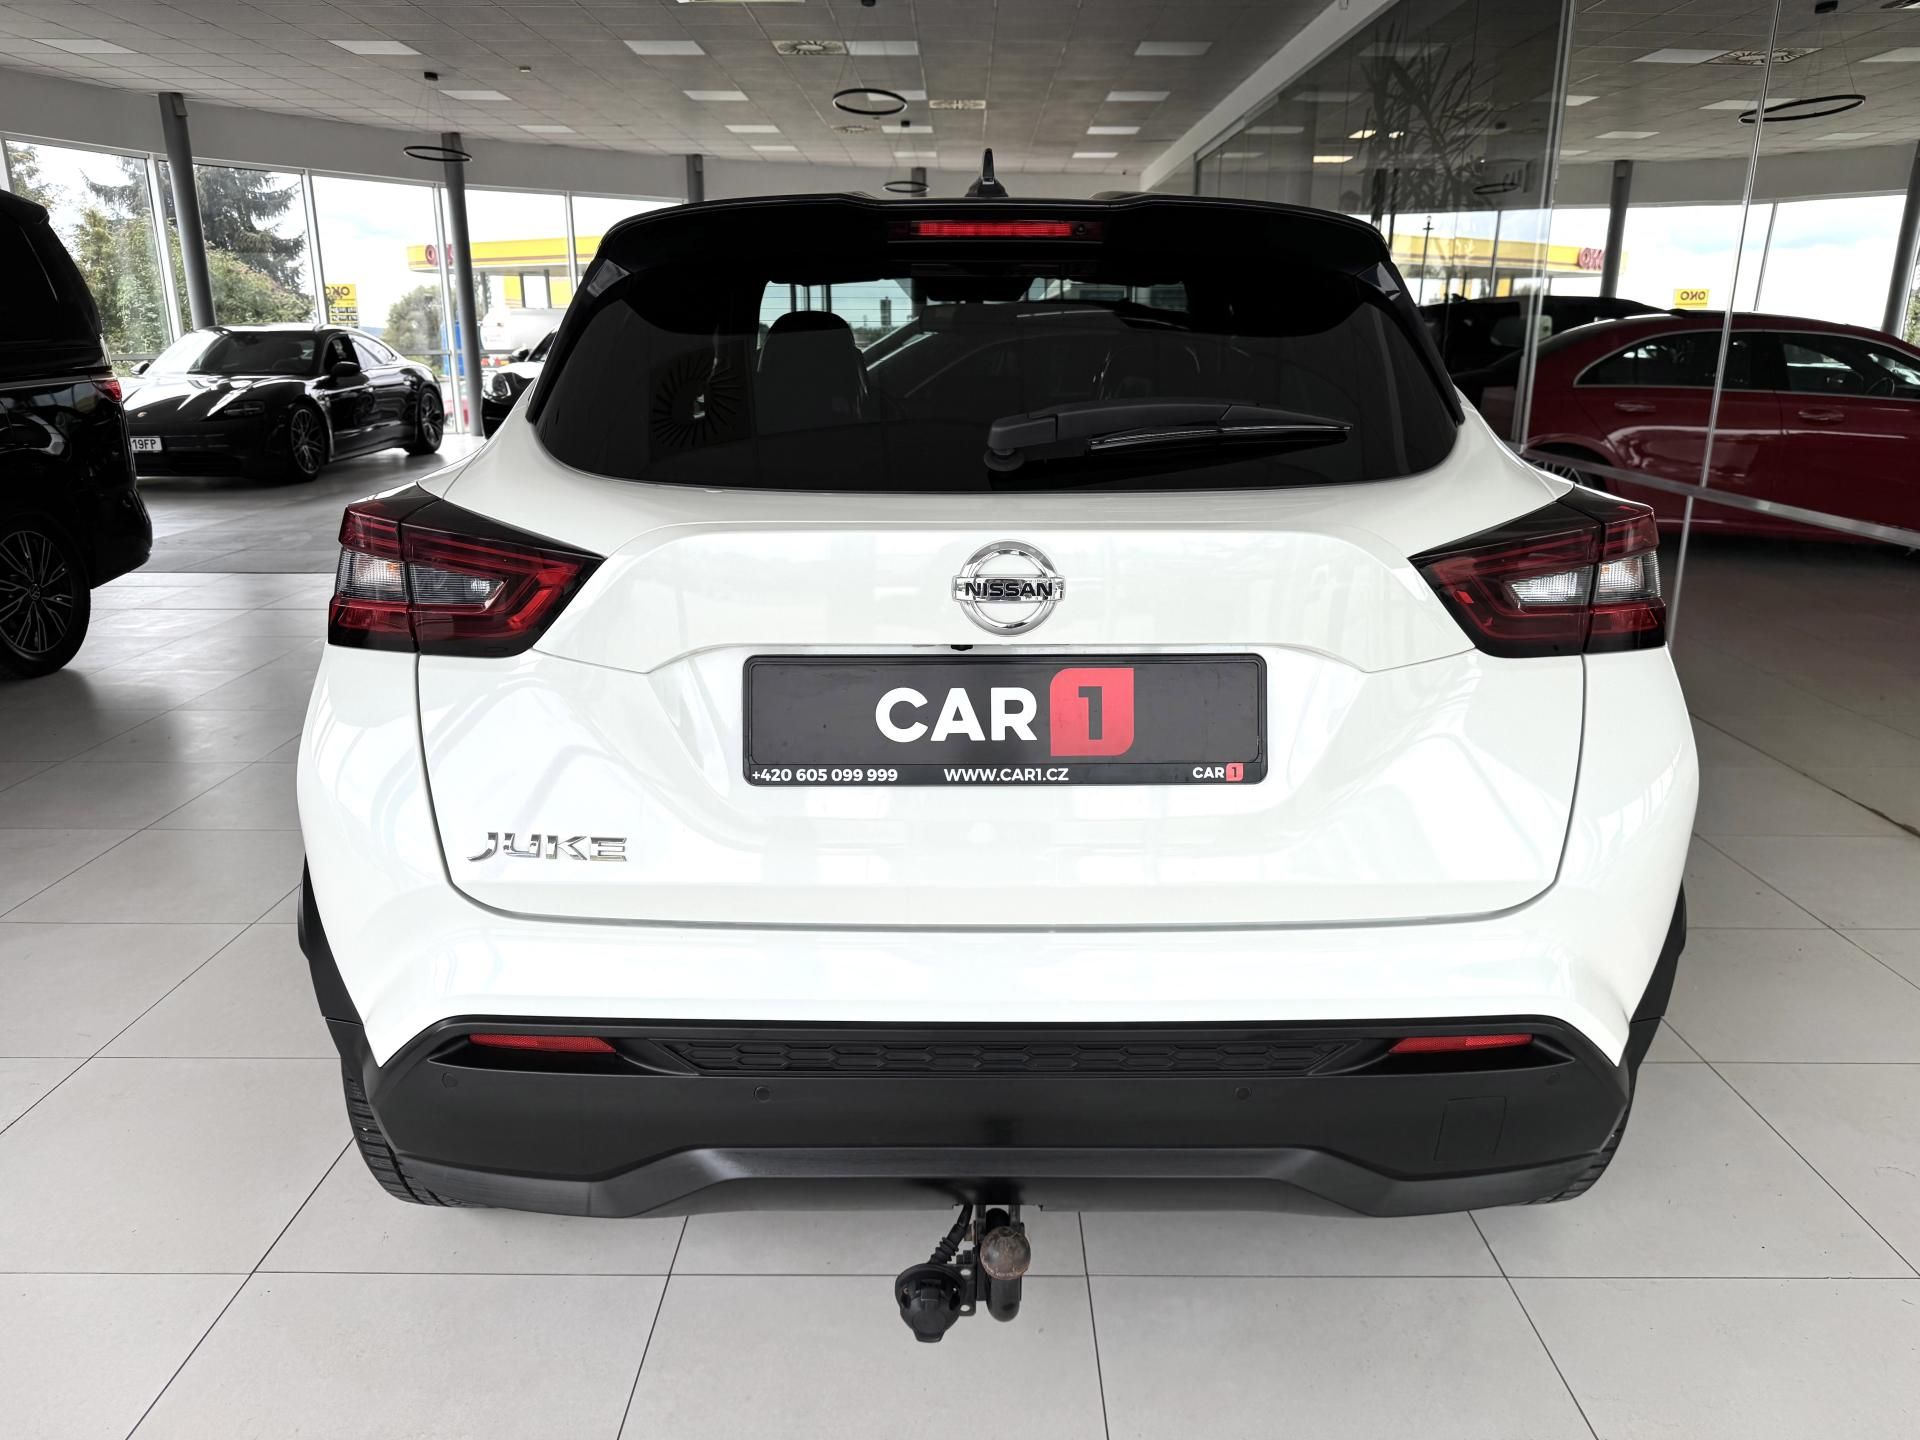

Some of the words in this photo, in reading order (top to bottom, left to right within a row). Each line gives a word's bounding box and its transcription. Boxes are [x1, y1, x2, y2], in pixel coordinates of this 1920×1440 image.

[965, 582, 1053, 597] NISSAN
[875, 687, 1038, 743] CAR
[752, 768, 793, 782] +420
[796, 768, 828, 782] 605
[831, 768, 864, 782] 099
[867, 768, 898, 782] 999
[943, 767, 1070, 782] WWW.CAR1.CZ
[466, 831, 628, 862] JUKE
